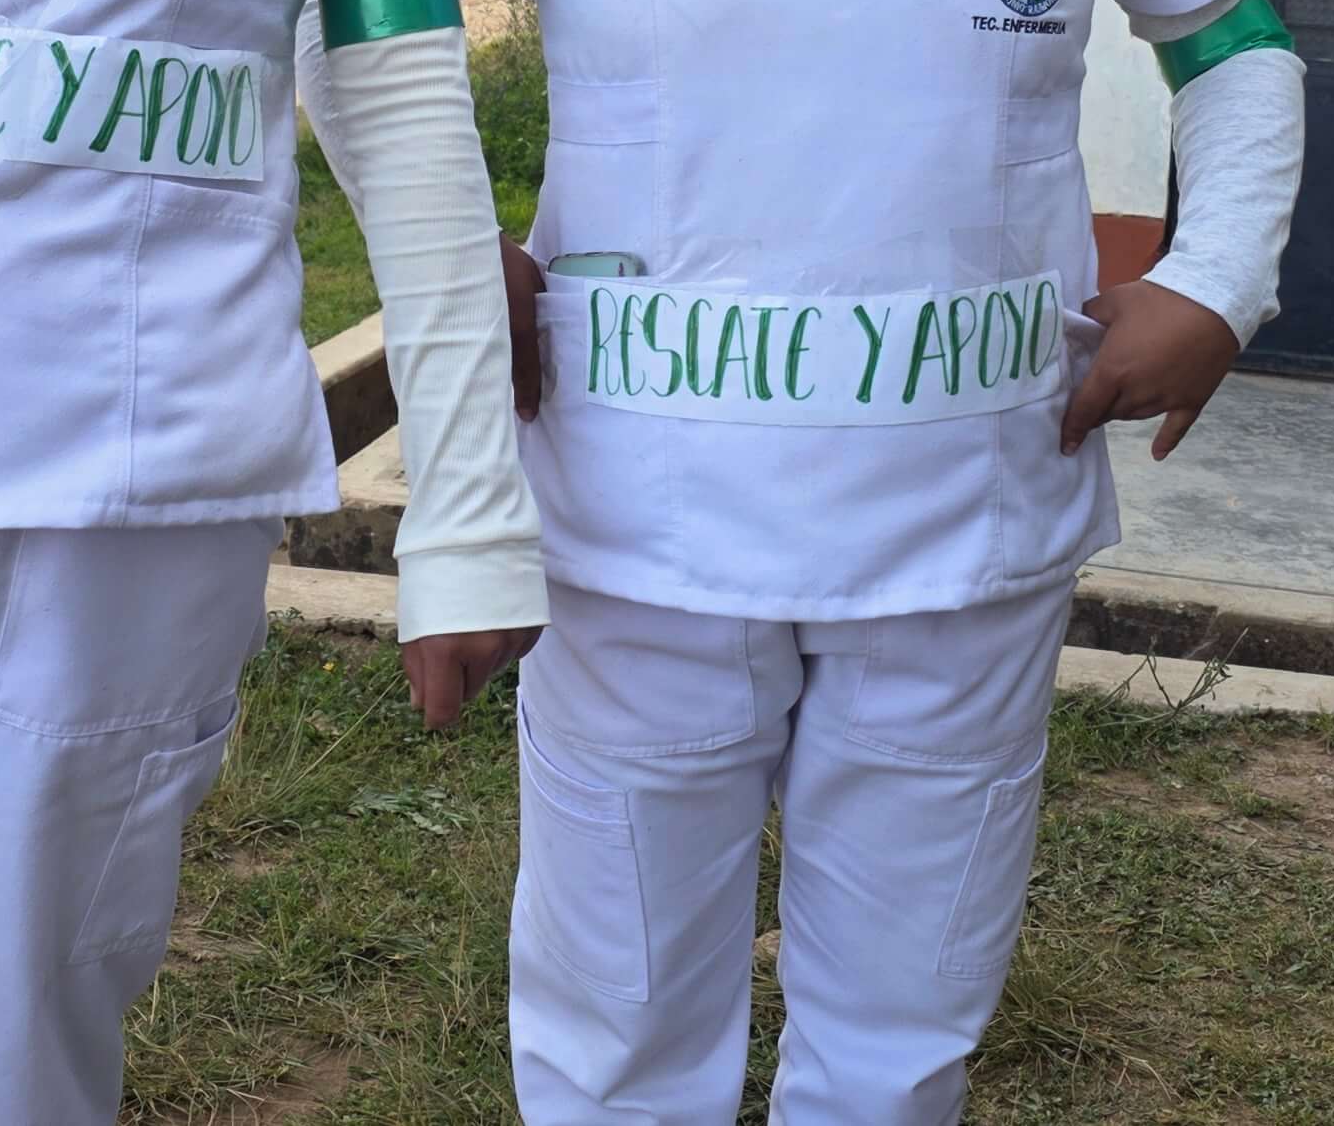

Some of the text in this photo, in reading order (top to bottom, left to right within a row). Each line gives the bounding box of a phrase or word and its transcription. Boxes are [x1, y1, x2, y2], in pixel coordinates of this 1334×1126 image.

[971, 15, 1066, 34] TEC. ENFERMERIA
[43, 40, 96, 144] Y
[88, 48, 258, 167] APOYO
[587, 280, 1059, 405] RESCATE Y APOYO
